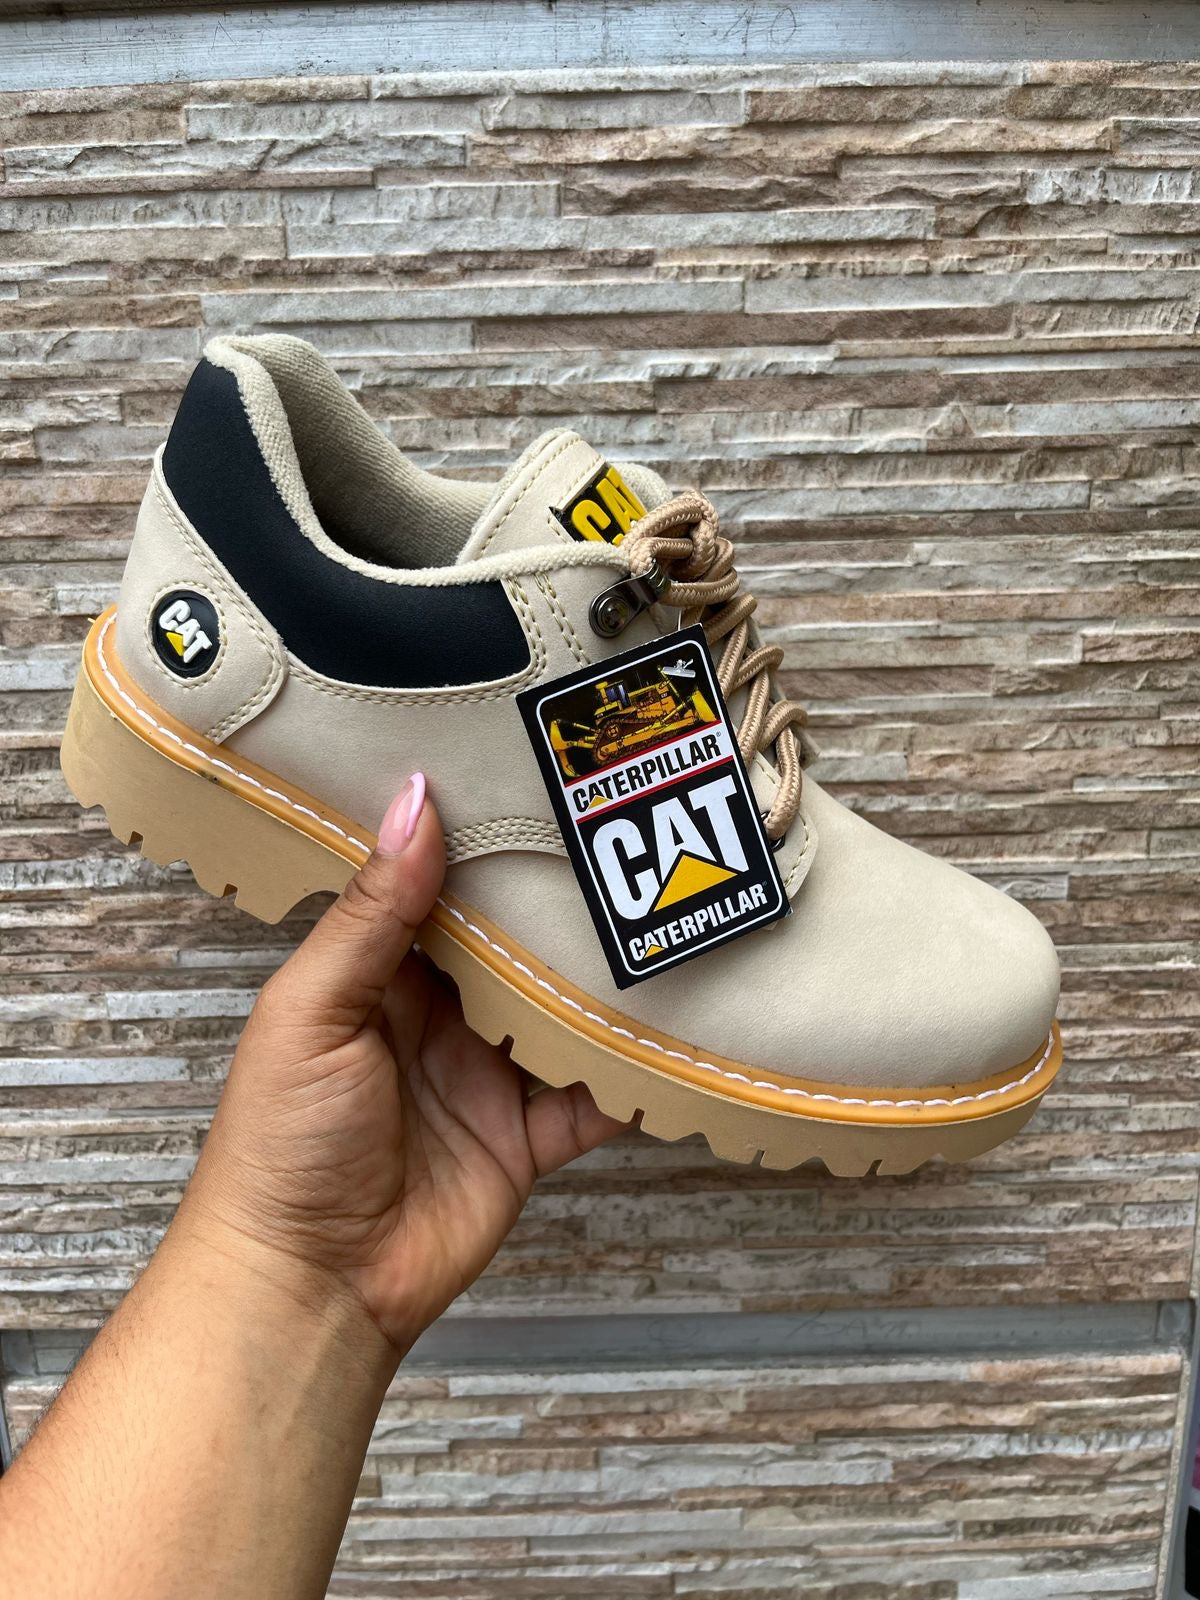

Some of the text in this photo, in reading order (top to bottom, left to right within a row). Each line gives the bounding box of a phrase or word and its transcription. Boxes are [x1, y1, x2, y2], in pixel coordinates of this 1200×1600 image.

[159, 600, 213, 664] CAT
[572, 733, 722, 813] CATERPILLAR
[592, 774, 750, 920] CAT
[628, 883, 768, 962] CATERPILLAR
